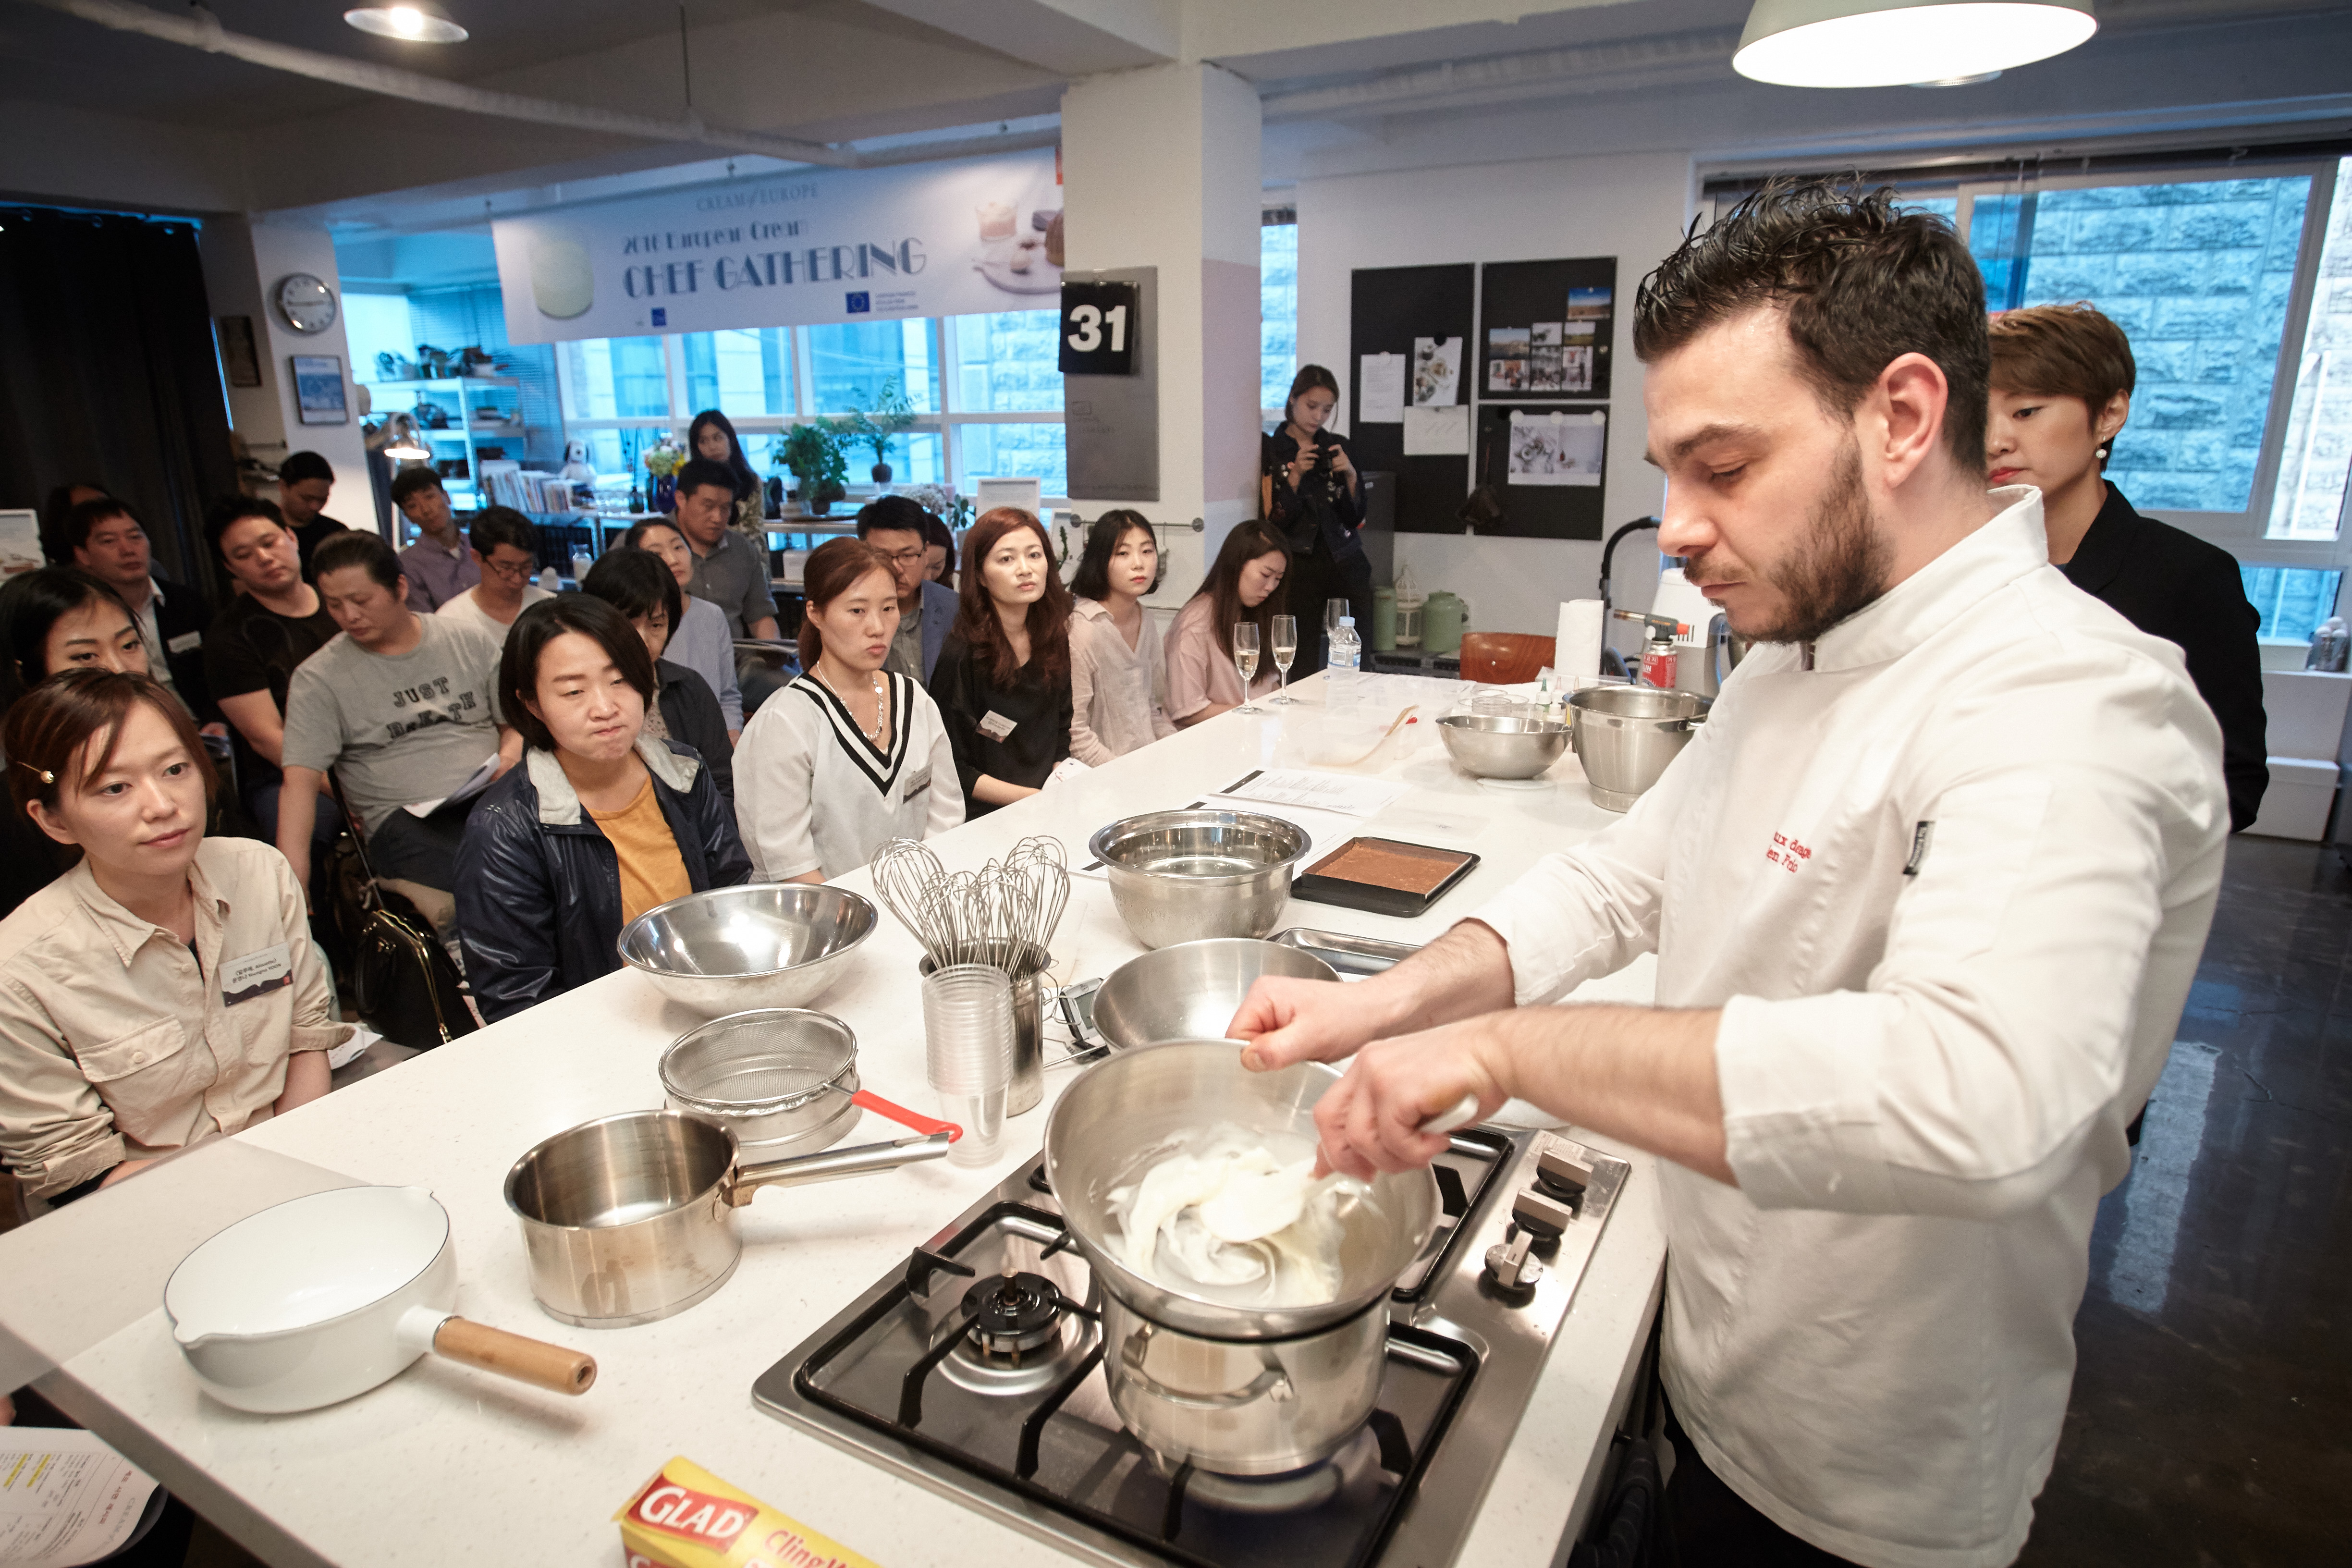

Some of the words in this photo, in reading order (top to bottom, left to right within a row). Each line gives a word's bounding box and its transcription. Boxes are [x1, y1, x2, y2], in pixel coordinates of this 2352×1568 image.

[760, 183, 817, 205] EUROPE
[665, 225, 744, 250] European
[749, 220, 809, 241] Cream
[623, 259, 705, 299] CHEF
[714, 237, 927, 292] GATHERING
[1067, 304, 1127, 353] 31
[393, 676, 449, 708] JUST
[639, 1486, 746, 1538] GLAD
